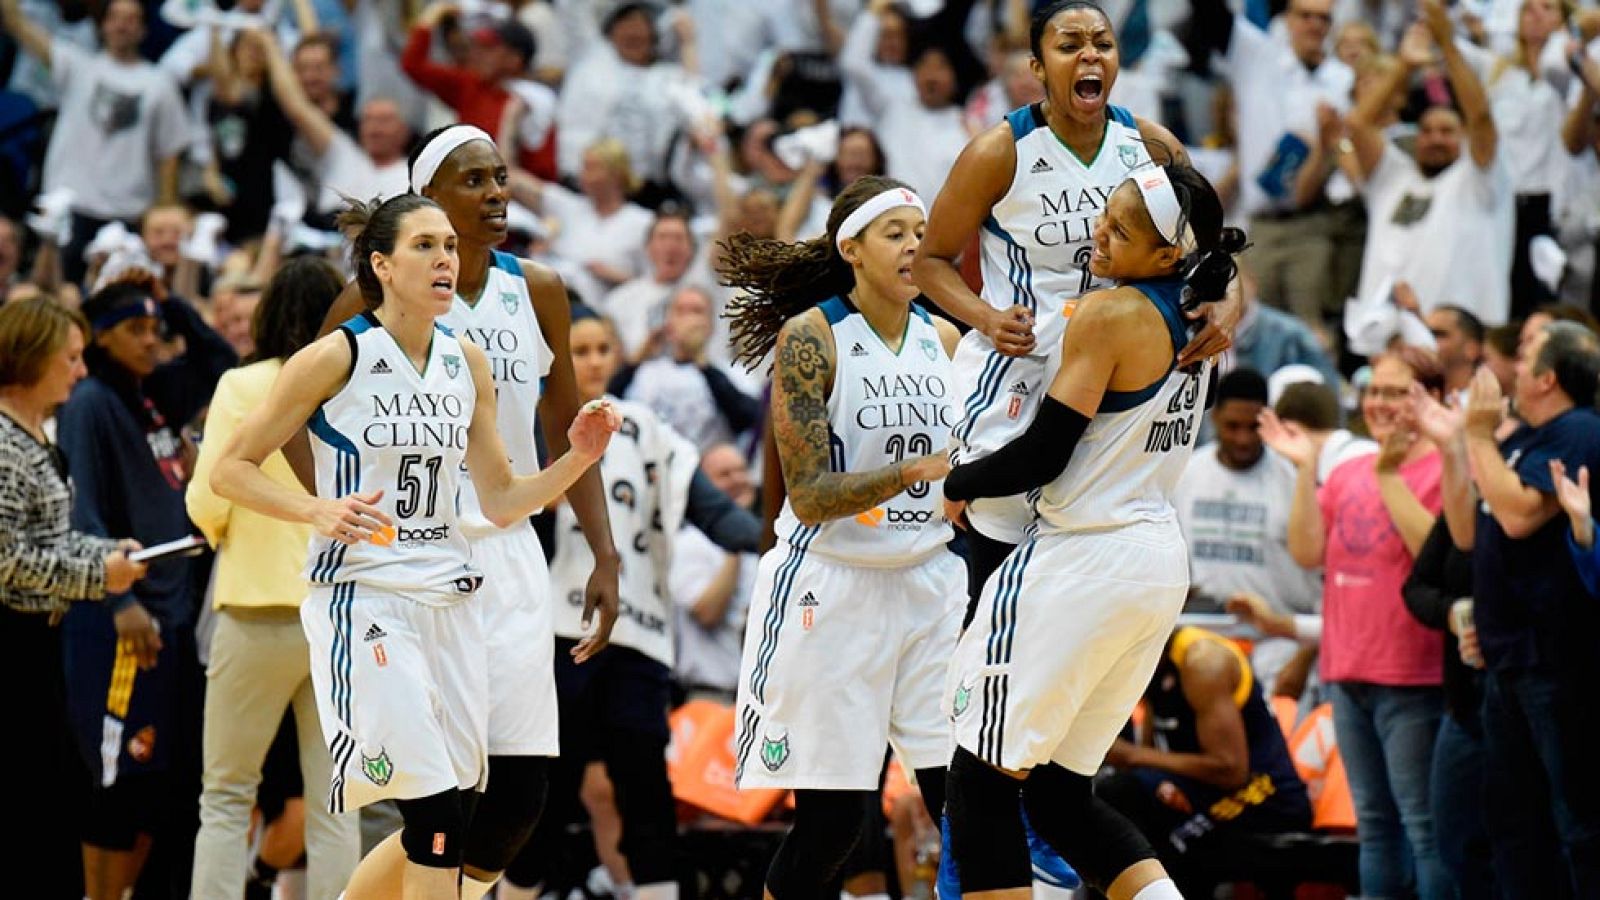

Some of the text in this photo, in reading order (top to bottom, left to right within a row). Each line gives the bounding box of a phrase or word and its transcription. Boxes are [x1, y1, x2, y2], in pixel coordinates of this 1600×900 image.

[1039, 185, 1115, 217] MAY
[1034, 216, 1093, 246] CLI
[463, 327, 518, 353] AYO
[862, 373, 946, 400] MAYO
[372, 393, 461, 419] MAYO
[396, 454, 442, 519] 51
[398, 523, 449, 541] boost
